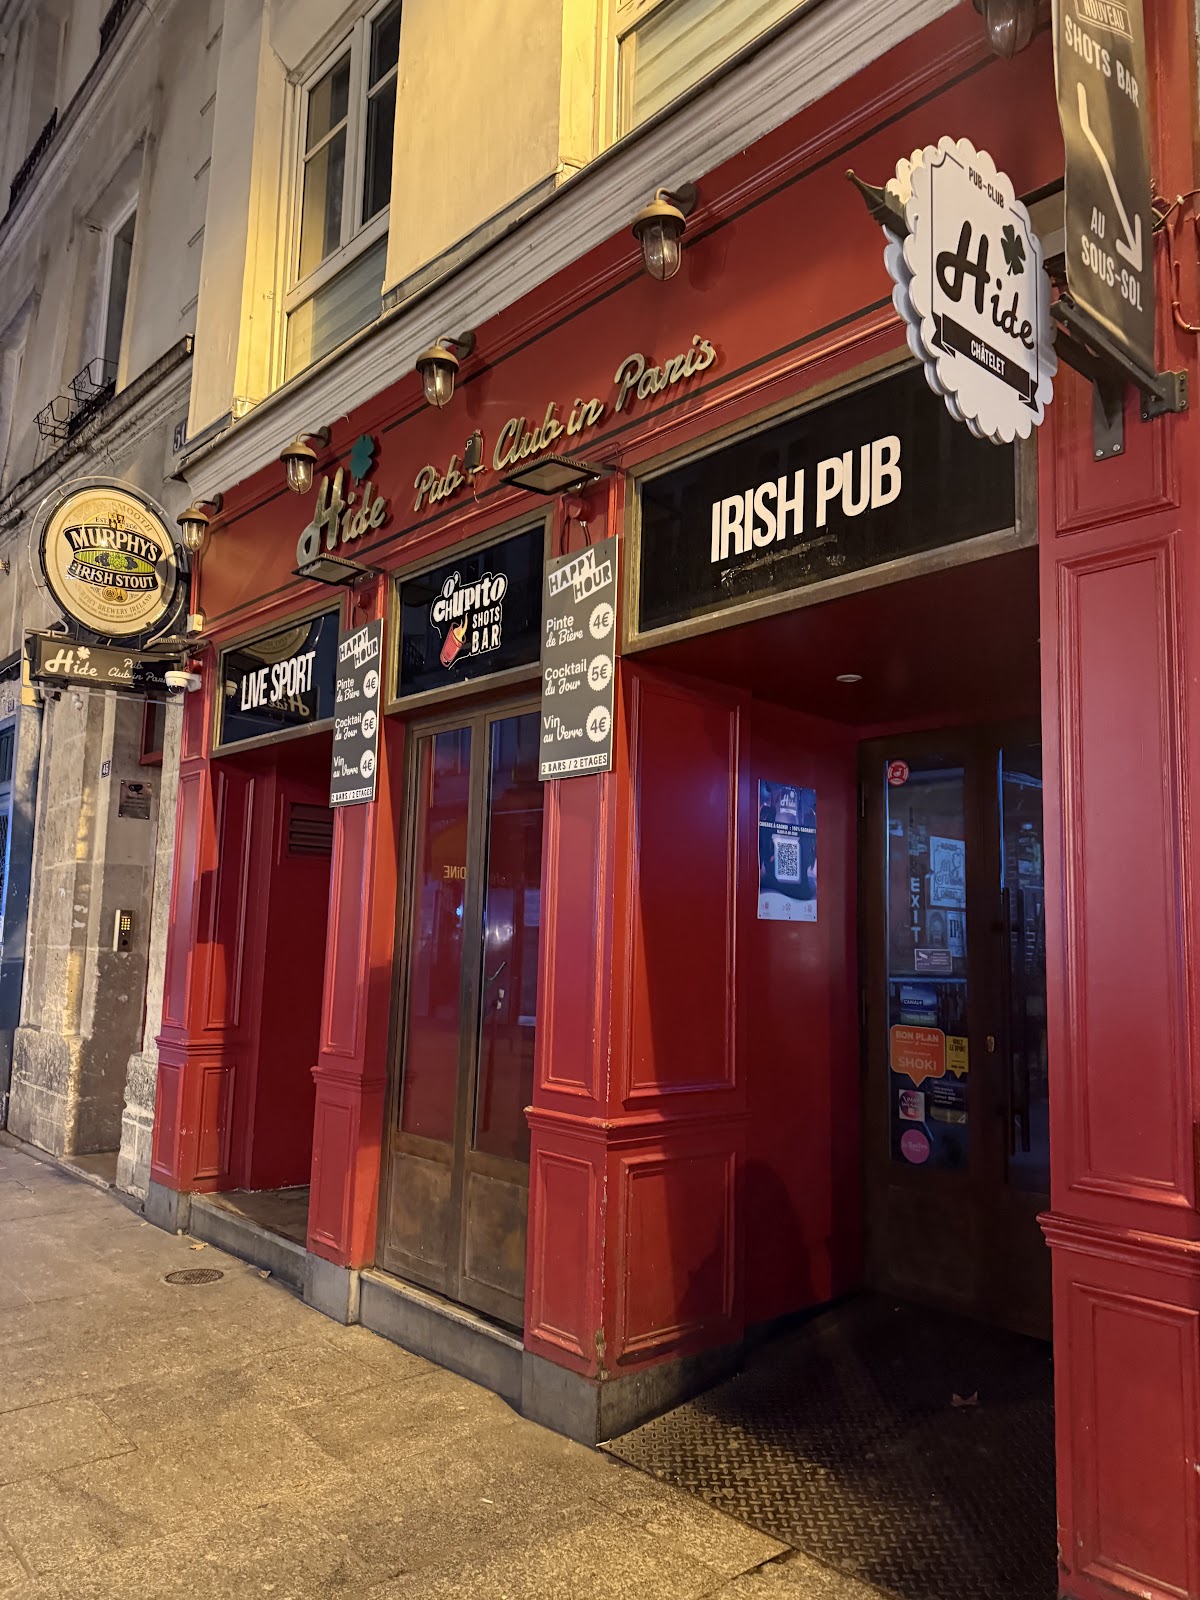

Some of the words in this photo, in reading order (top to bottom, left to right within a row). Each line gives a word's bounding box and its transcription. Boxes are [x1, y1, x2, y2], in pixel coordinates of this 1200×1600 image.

[1083, 0, 1125, 30] NOUVEAU
[1065, 14, 1111, 78] SHOTS
[1116, 59, 1140, 109] BAR
[968, 166, 1004, 209] PUB-CLUB
[1090, 206, 1105, 239] AU
[1081, 234, 1143, 312] SOUS-SOL
[935, 220, 1034, 350] Hide
[970, 339, 1006, 376] CHÂTELET
[413, 454, 465, 512] Pub
[492, 401, 562, 471] Club
[561, 397, 604, 436] in
[613, 334, 717, 412] Paris
[710, 468, 804, 563] IRISH
[816, 435, 902, 528] PUB
[296, 466, 386, 567] Hide
[75, 563, 113, 584] IRISH
[115, 573, 153, 588] STOUT
[550, 552, 594, 594] HAPPY
[574, 565, 610, 601] HOUR
[472, 605, 500, 629] SHOTS
[546, 615, 574, 633] Pinte
[593, 611, 610, 630] 4€
[339, 629, 368, 660] HAPPY
[471, 624, 499, 653] BAR
[545, 633, 557, 648] de
[559, 627, 583, 646] Bière
[44, 649, 98, 676] Hide
[354, 640, 378, 666] HOUR
[107, 667, 131, 679] Club
[131, 672, 143, 680] in
[124, 658, 143, 670] Pub
[544, 659, 587, 681] Cocktail
[591, 663, 609, 682] 5€
[241, 667, 269, 711] LIVE
[270, 650, 316, 702] SPORT
[337, 677, 355, 691] Pinte
[366, 677, 376, 691] 4€
[544, 680, 556, 696] du
[558, 678, 581, 695] Jour
[336, 689, 343, 703] de
[335, 712, 362, 729] Cocktail
[364, 717, 374, 731] 5€
[543, 716, 560, 730] Vin
[590, 717, 607, 734] 4€
[334, 727, 342, 740] du
[343, 726, 358, 740] Jour
[543, 731, 554, 743] au
[557, 724, 583, 741] Verre
[333, 755, 345, 768] Vin
[341, 763, 359, 776] Verre
[362, 758, 373, 772] 4€
[542, 763, 546, 772] 2
[548, 760, 567, 771] BARS
[574, 759, 578, 768] 2
[580, 754, 607, 767] ETAGES
[356, 788, 373, 798] ETAGES
[910, 877, 921, 943] EXIT
[895, 1031, 914, 1040] BON
[915, 1032, 939, 1043] PLAN
[898, 1057, 937, 1071] SHOKI
